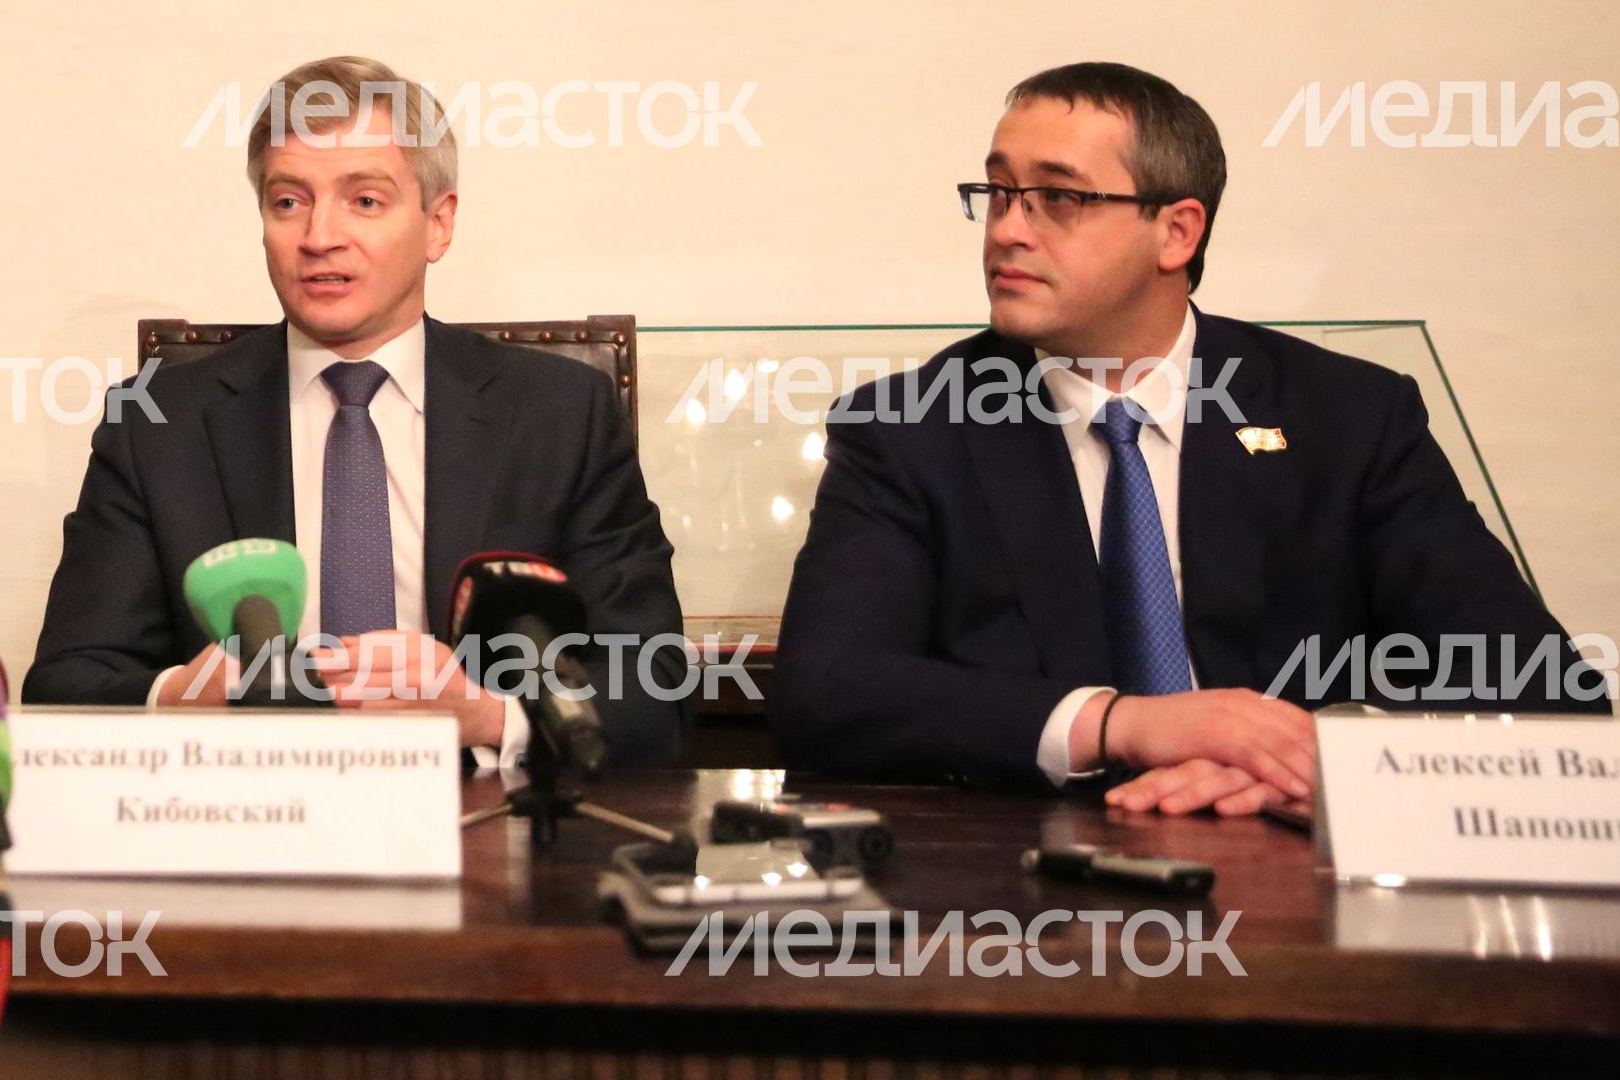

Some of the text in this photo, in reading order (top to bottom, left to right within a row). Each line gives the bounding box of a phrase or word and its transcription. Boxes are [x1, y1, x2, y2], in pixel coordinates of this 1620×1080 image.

[11, 739, 443, 775] лександр Владимирович
[1375, 743, 1542, 777] Алексей
[115, 796, 306, 824] Кибовский
[1453, 805, 1620, 841] Шапош
